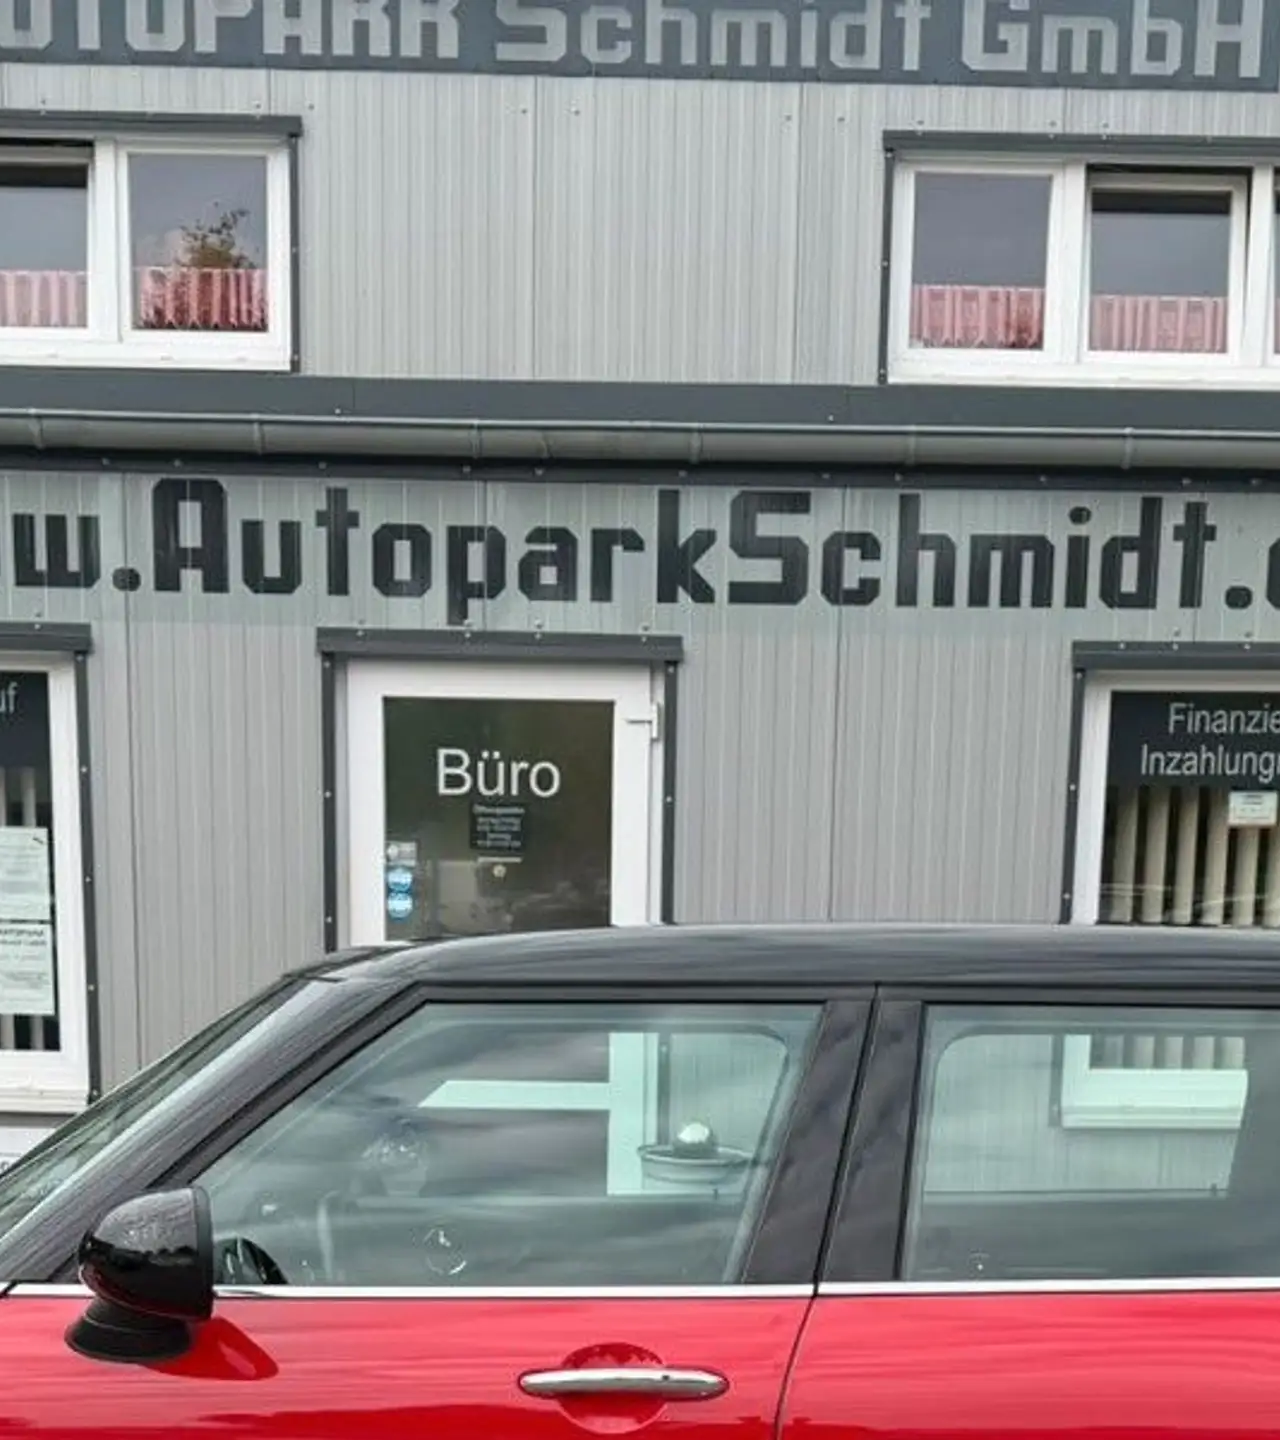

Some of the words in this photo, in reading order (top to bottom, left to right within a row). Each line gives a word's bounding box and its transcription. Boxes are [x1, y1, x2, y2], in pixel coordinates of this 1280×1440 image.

[496, 0, 931, 71] Schmidt
[962, 0, 1263, 78] GmbH
[436, 747, 561, 798] Büro
